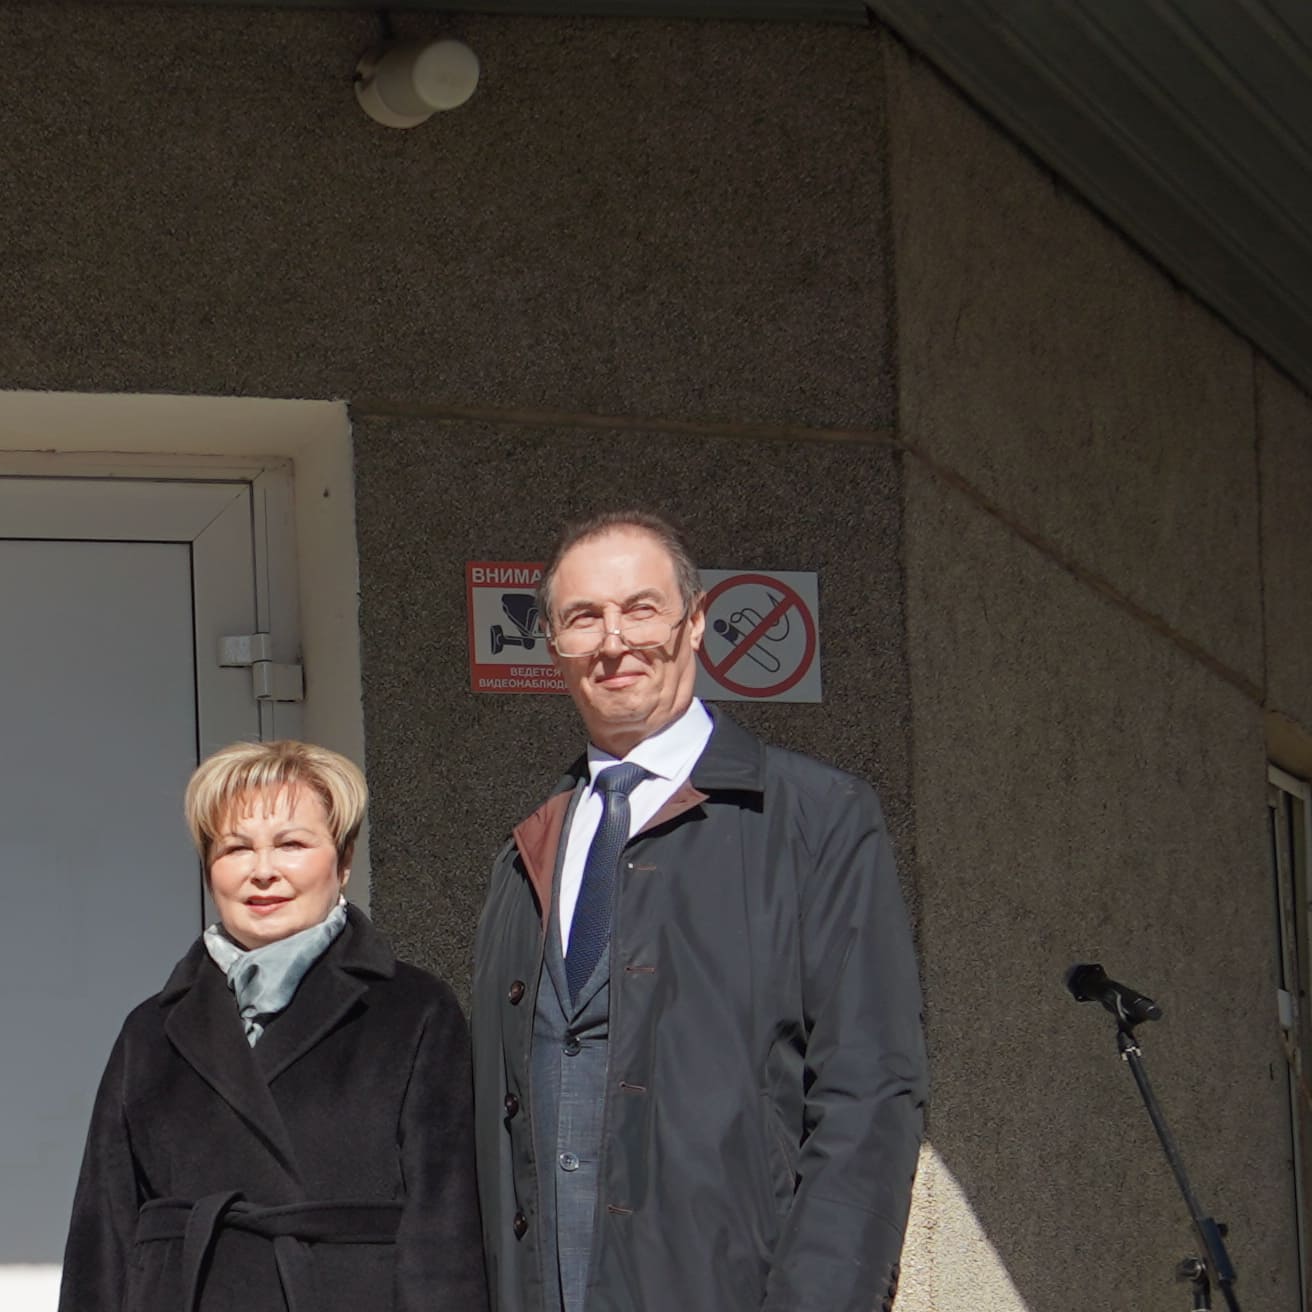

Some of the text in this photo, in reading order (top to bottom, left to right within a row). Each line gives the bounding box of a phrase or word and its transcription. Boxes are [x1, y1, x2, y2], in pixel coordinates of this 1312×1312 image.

[472, 567, 542, 584] ВНИМА
[510, 667, 562, 677] ВЕДЕТСЯ
[479, 678, 568, 689] ВИДЕОНАБЛЮД
